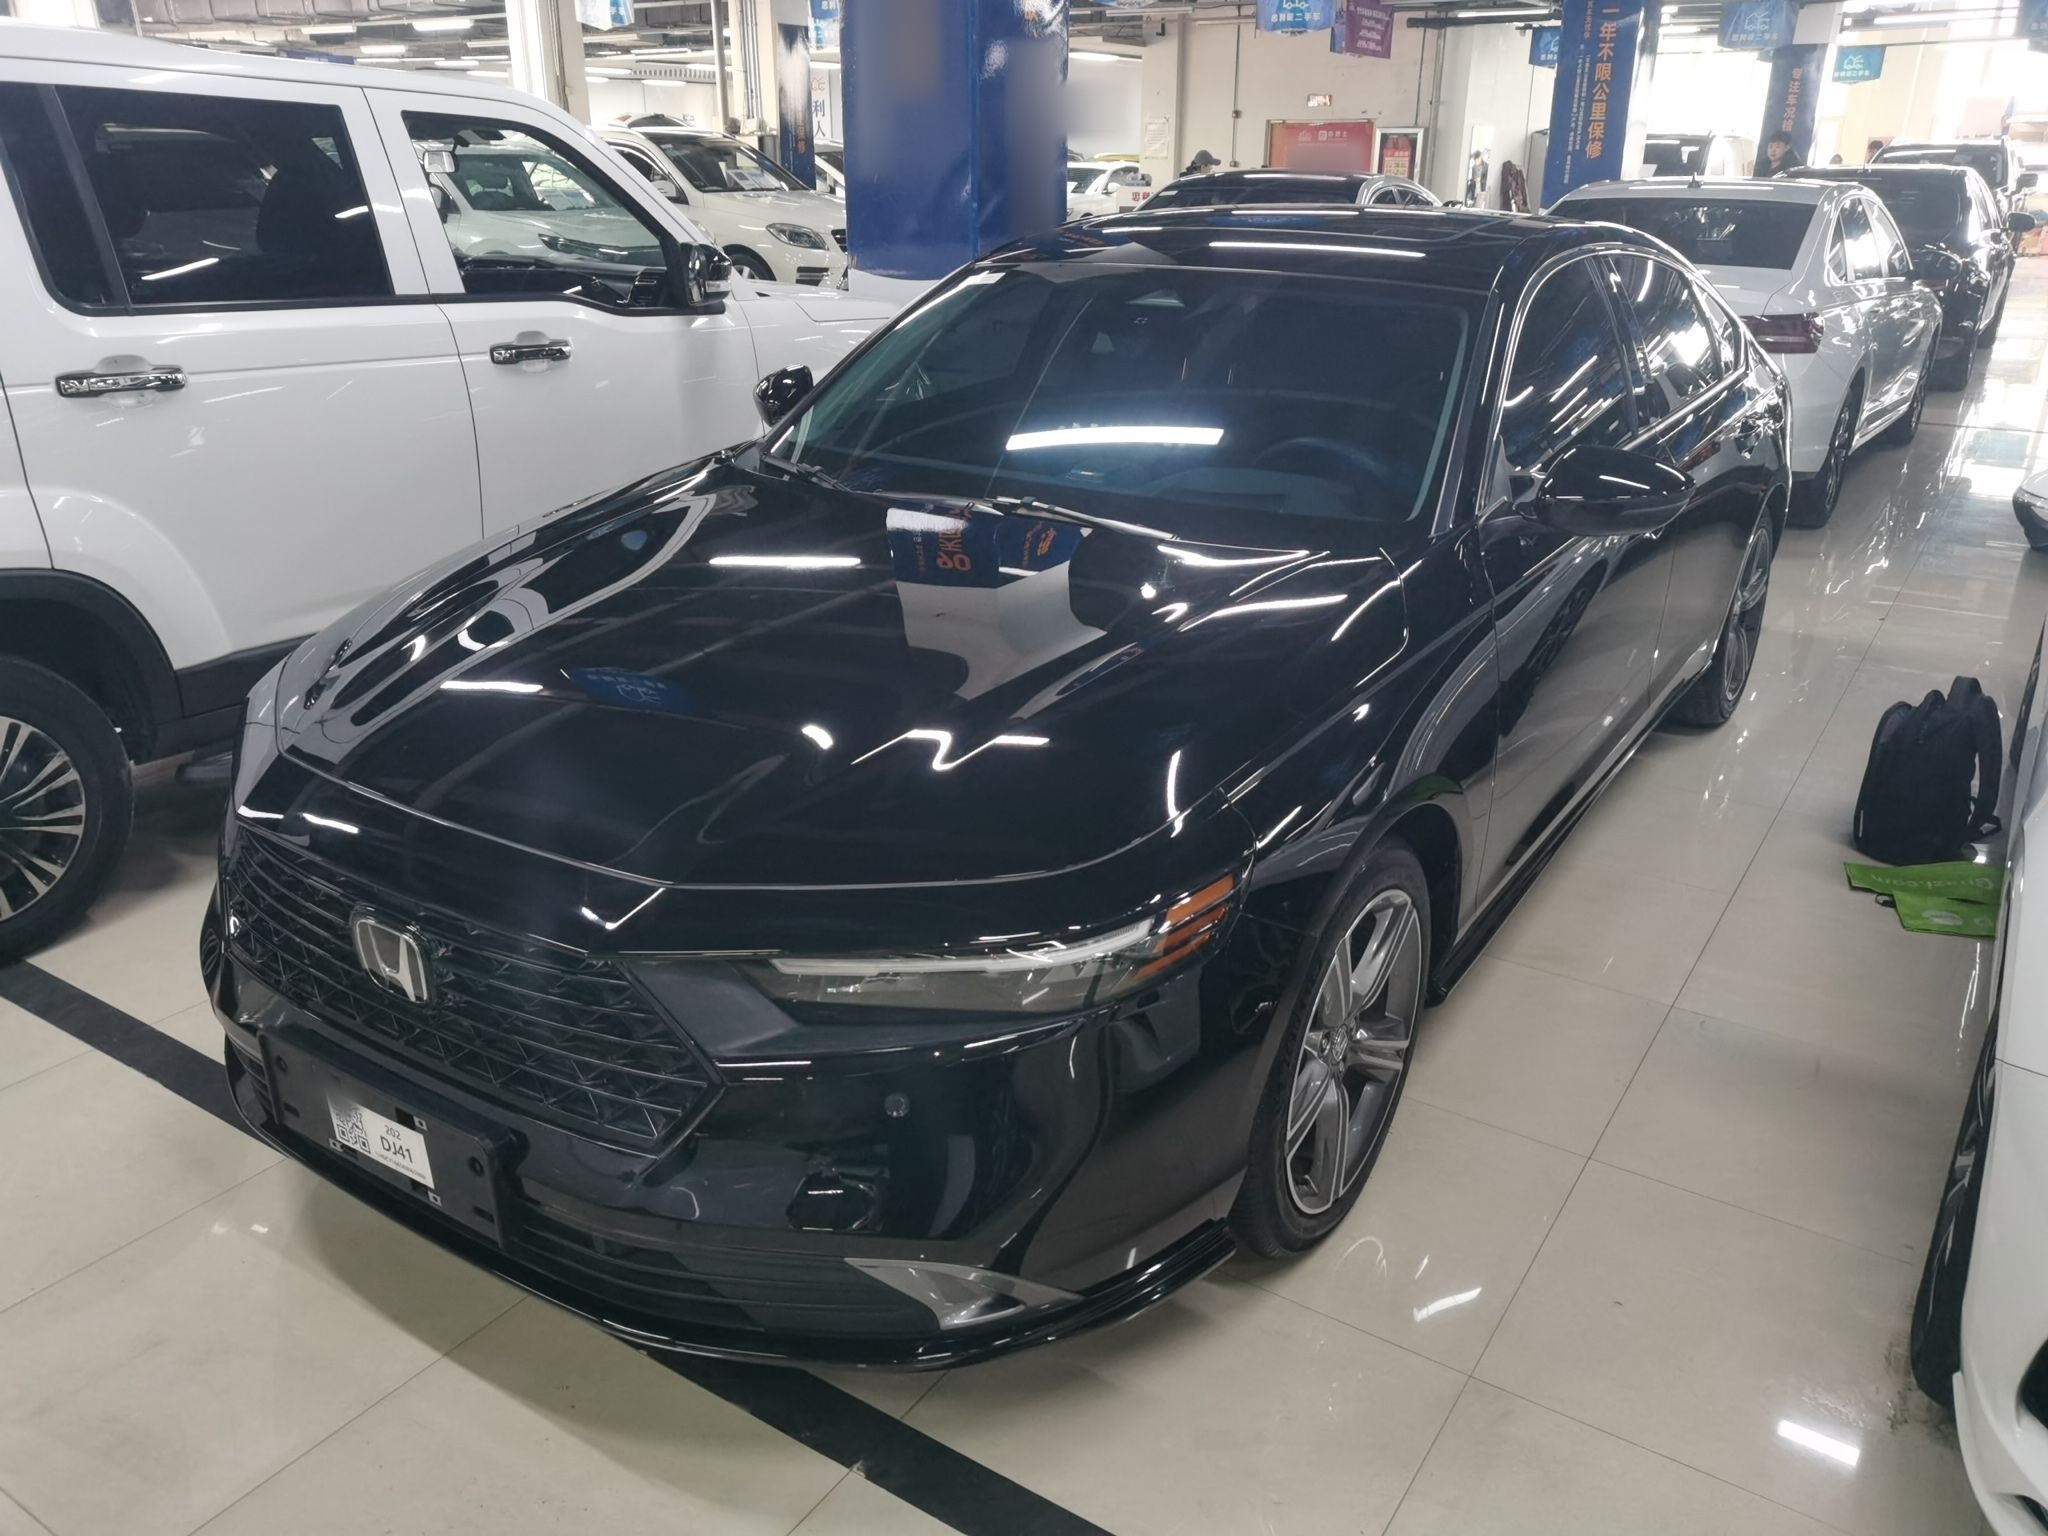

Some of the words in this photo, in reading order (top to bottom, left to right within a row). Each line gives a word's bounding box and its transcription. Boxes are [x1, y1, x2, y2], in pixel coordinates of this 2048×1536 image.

[1587, 8, 1621, 160] 一年不限公里保修
[384, 1124, 402, 1141] 202
[380, 1136, 413, 1164] DJ41
